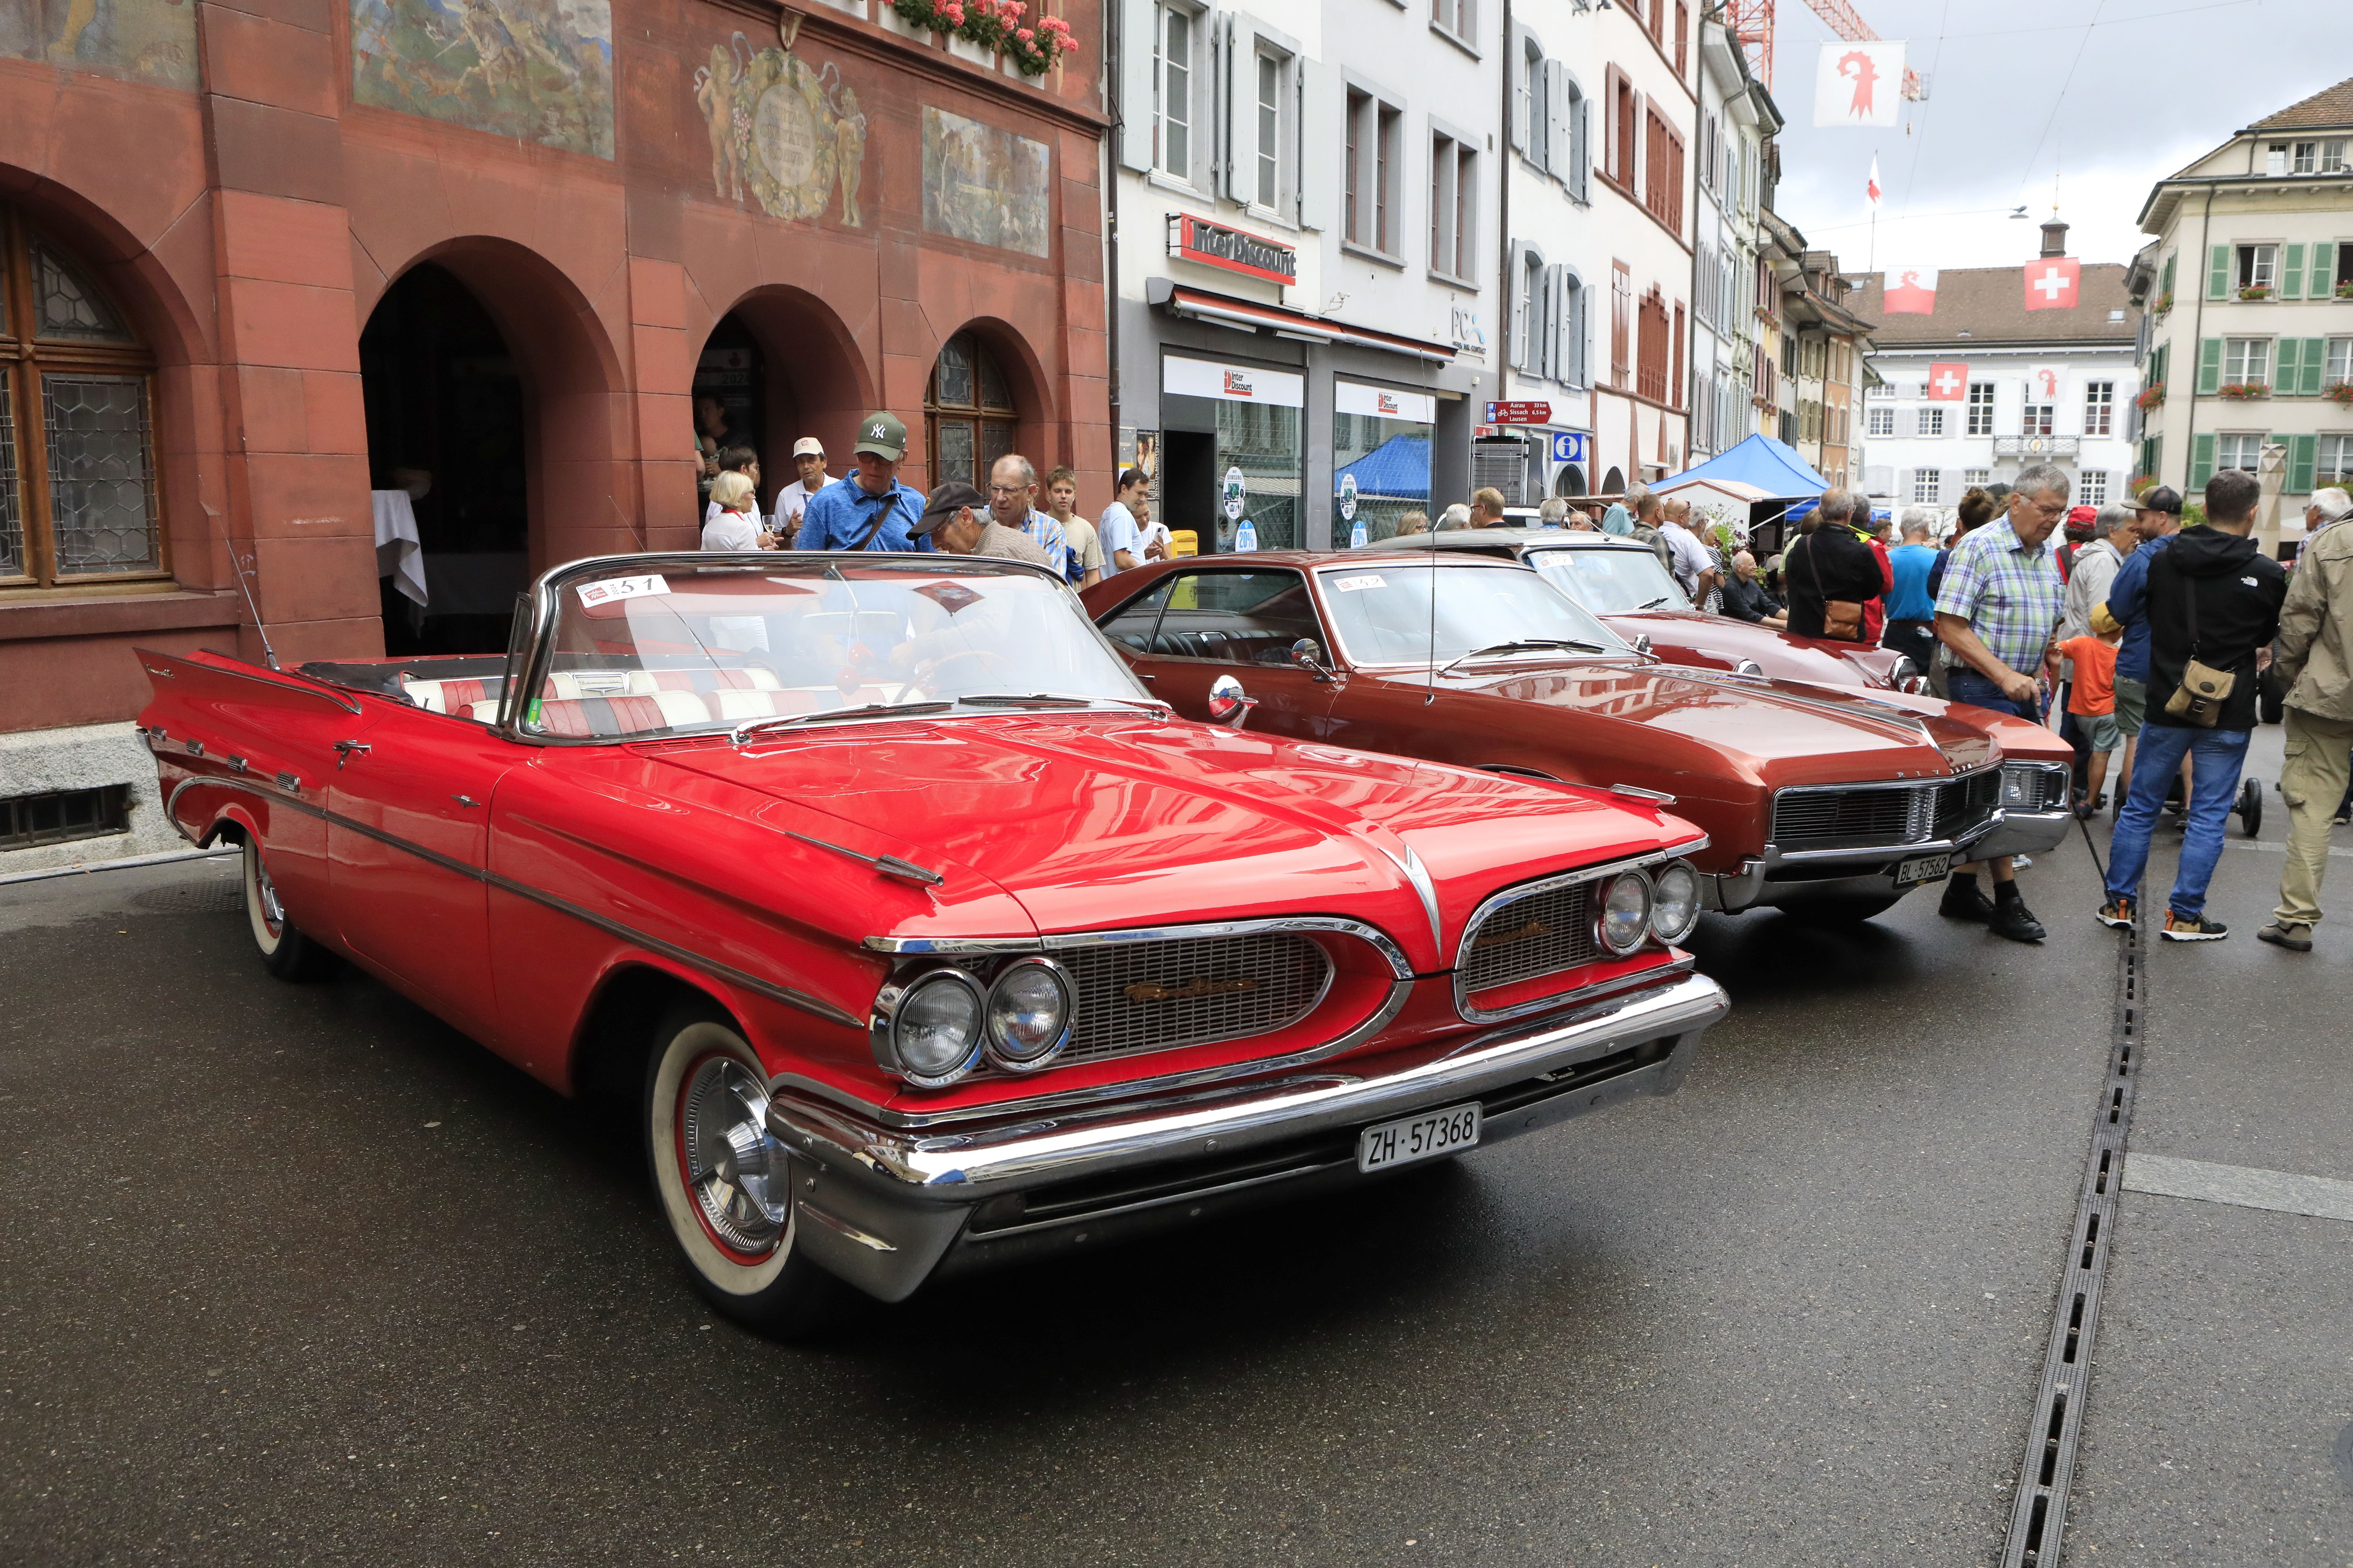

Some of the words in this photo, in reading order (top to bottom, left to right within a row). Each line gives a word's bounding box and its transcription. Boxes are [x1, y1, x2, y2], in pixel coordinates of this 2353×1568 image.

[1472, 346, 1486, 354] CONTACT
[1231, 372, 1243, 381] Inter
[1231, 381, 1252, 391] Discount
[1383, 401, 1398, 410] Discount
[871, 423, 886, 439] NY
[1239, 531, 1254, 548] 20%
[1354, 530, 1365, 545] 20%
[621, 578, 652, 594] 51
